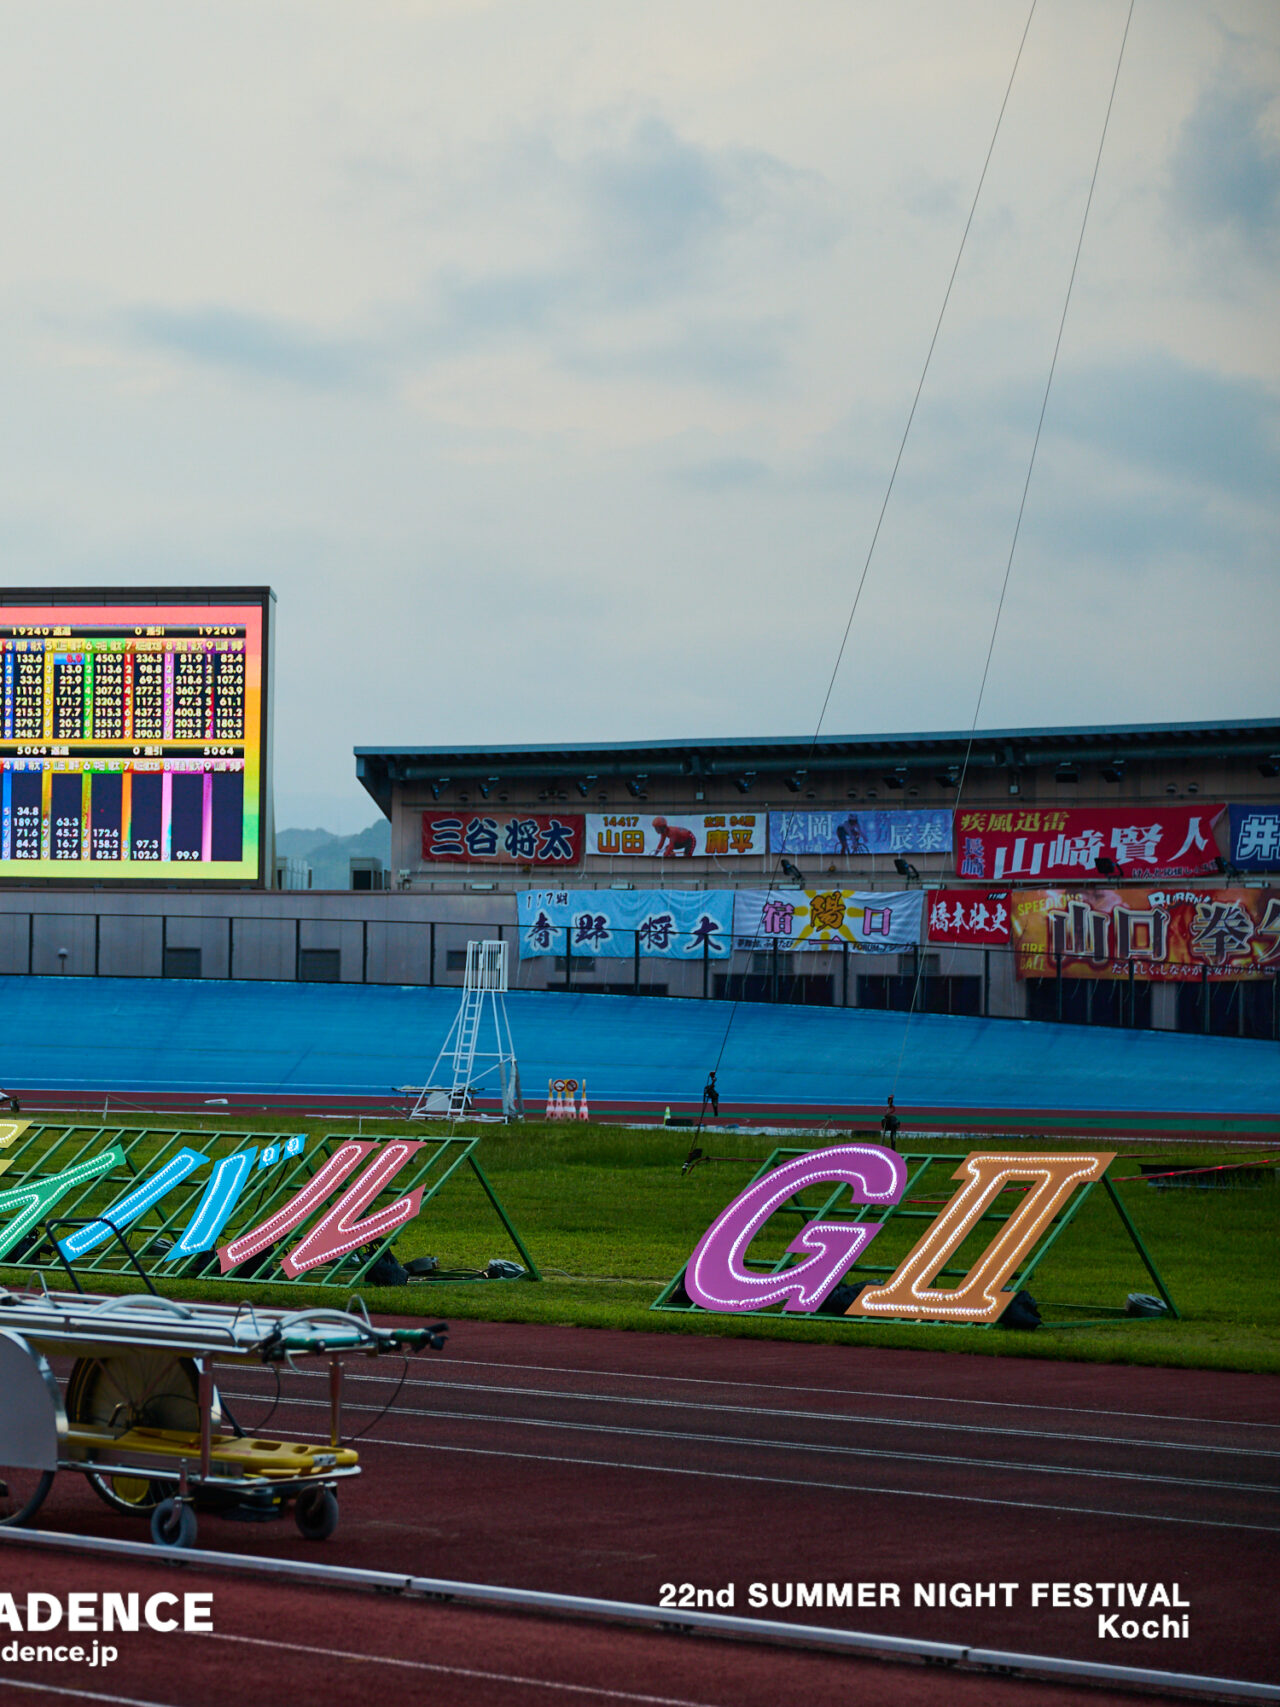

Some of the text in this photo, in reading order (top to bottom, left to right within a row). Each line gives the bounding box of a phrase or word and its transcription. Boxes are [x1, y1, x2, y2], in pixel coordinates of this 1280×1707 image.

[12, 627, 50, 636] 19240
[198, 626, 236, 636] 19240
[17, 654, 42, 663] 133.6
[136, 654, 162, 662] 236.5
[180, 654, 202, 662] 81.9
[221, 654, 242, 662] 82.4
[20, 665, 41, 674] 70.7
[61, 665, 82, 673] 13.0
[140, 665, 161, 673] 98.8
[180, 665, 202, 673] 73.2
[221, 665, 242, 673] 23.0
[20, 676, 41, 684] 33.6
[60, 676, 81, 684] 22.9
[140, 676, 161, 684] 69.3
[176, 676, 202, 684] 218.6
[217, 676, 242, 684] 107.6
[17, 686, 41, 695] 111.0
[60, 687, 81, 695] 71.4
[176, 686, 202, 694] 360.7
[217, 686, 242, 695] 163.9
[16, 697, 41, 705] 721.5
[57, 697, 81, 705] 171.7
[137, 697, 161, 705] 117.3
[179, 697, 201, 706] 47.3
[220, 697, 240, 706] 61.1
[16, 708, 41, 716] 215.3
[60, 708, 80, 716] 57.7
[135, 708, 161, 716] 437.2
[175, 708, 201, 716] 400.8
[217, 708, 242, 716] 121.2
[15, 719, 40, 727] 379.7
[59, 719, 80, 727] 20.2
[135, 719, 161, 727] 222.0
[176, 719, 201, 727] 203.2
[216, 719, 241, 727] 180.3
[15, 729, 40, 738] 248.7
[59, 730, 80, 738] 37.4
[135, 730, 161, 738] 390.0
[175, 730, 201, 738] 225.4
[216, 730, 242, 738] 163.9
[17, 746, 47, 755] 5064
[203, 746, 234, 755] 5064
[18, 807, 38, 815] 34.8
[14, 818, 38, 826] 189.9
[57, 818, 78, 826] 63.3
[960, 811, 1070, 833] 疾風迅雷
[17, 829, 38, 837] 71.6
[56, 829, 78, 837] 45.2
[94, 829, 118, 837] 172.6
[780, 813, 832, 842] 松岡
[889, 822, 945, 851] 辰泰
[430, 816, 574, 860] 三谷将太
[598, 829, 644, 854] 山田
[16, 840, 37, 848] 84.4
[57, 840, 77, 848] 16.7
[93, 840, 118, 848] 158.2
[136, 840, 158, 848] 97.3
[16, 850, 38, 858] 86.3
[56, 850, 78, 859] 22.6
[96, 851, 118, 859] 82.5
[133, 850, 159, 859] 102.6
[177, 851, 198, 859] 99.9
[929, 901, 1009, 935] 橋本壮史
